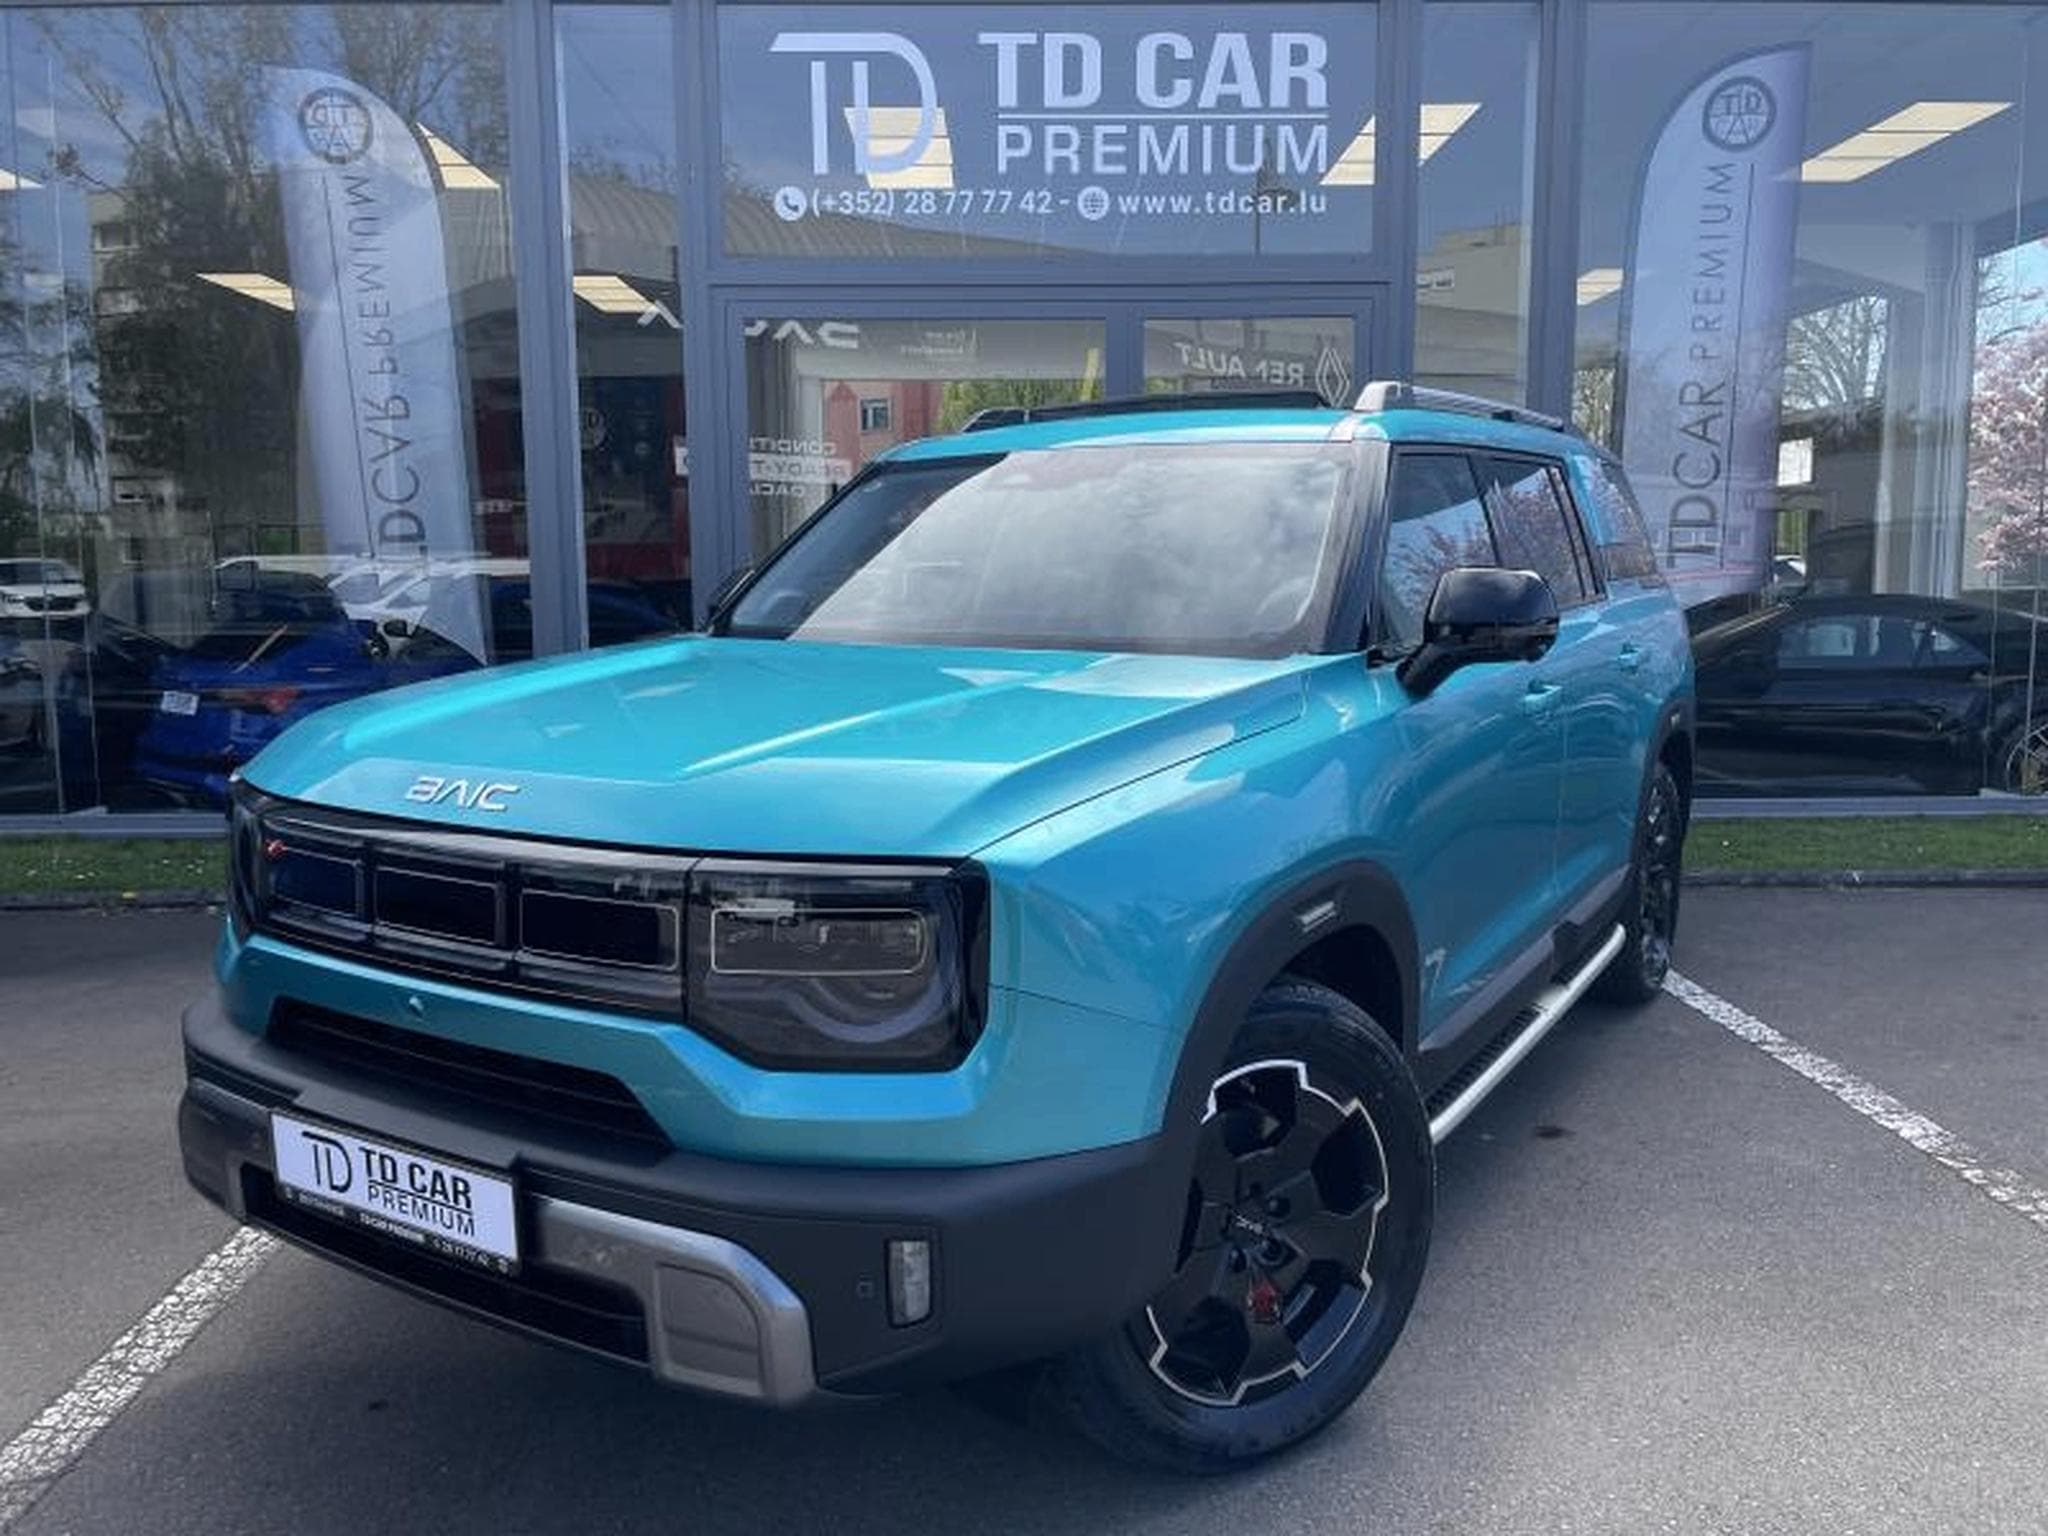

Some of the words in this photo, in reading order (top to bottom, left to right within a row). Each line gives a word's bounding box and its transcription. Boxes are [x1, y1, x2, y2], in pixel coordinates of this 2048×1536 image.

[978, 33, 1101, 107] TD
[1136, 33, 1328, 108] CAR
[998, 125, 1328, 174] PREMIUM
[813, 188, 894, 217] (+352)
[904, 191, 936, 214] 28
[945, 190, 974, 214] 77
[982, 190, 1012, 214] 77
[1019, 190, 1053, 214] 42
[1117, 189, 1327, 214] www.tdcar.lu
[1690, 162, 1735, 361] PREMIUM
[406, 776, 520, 812] BAIC
[302, 1131, 351, 1193] TD
[359, 1147, 398, 1184] TD
[408, 1163, 472, 1209] CAR
[368, 1185, 475, 1237] PREMIUM
